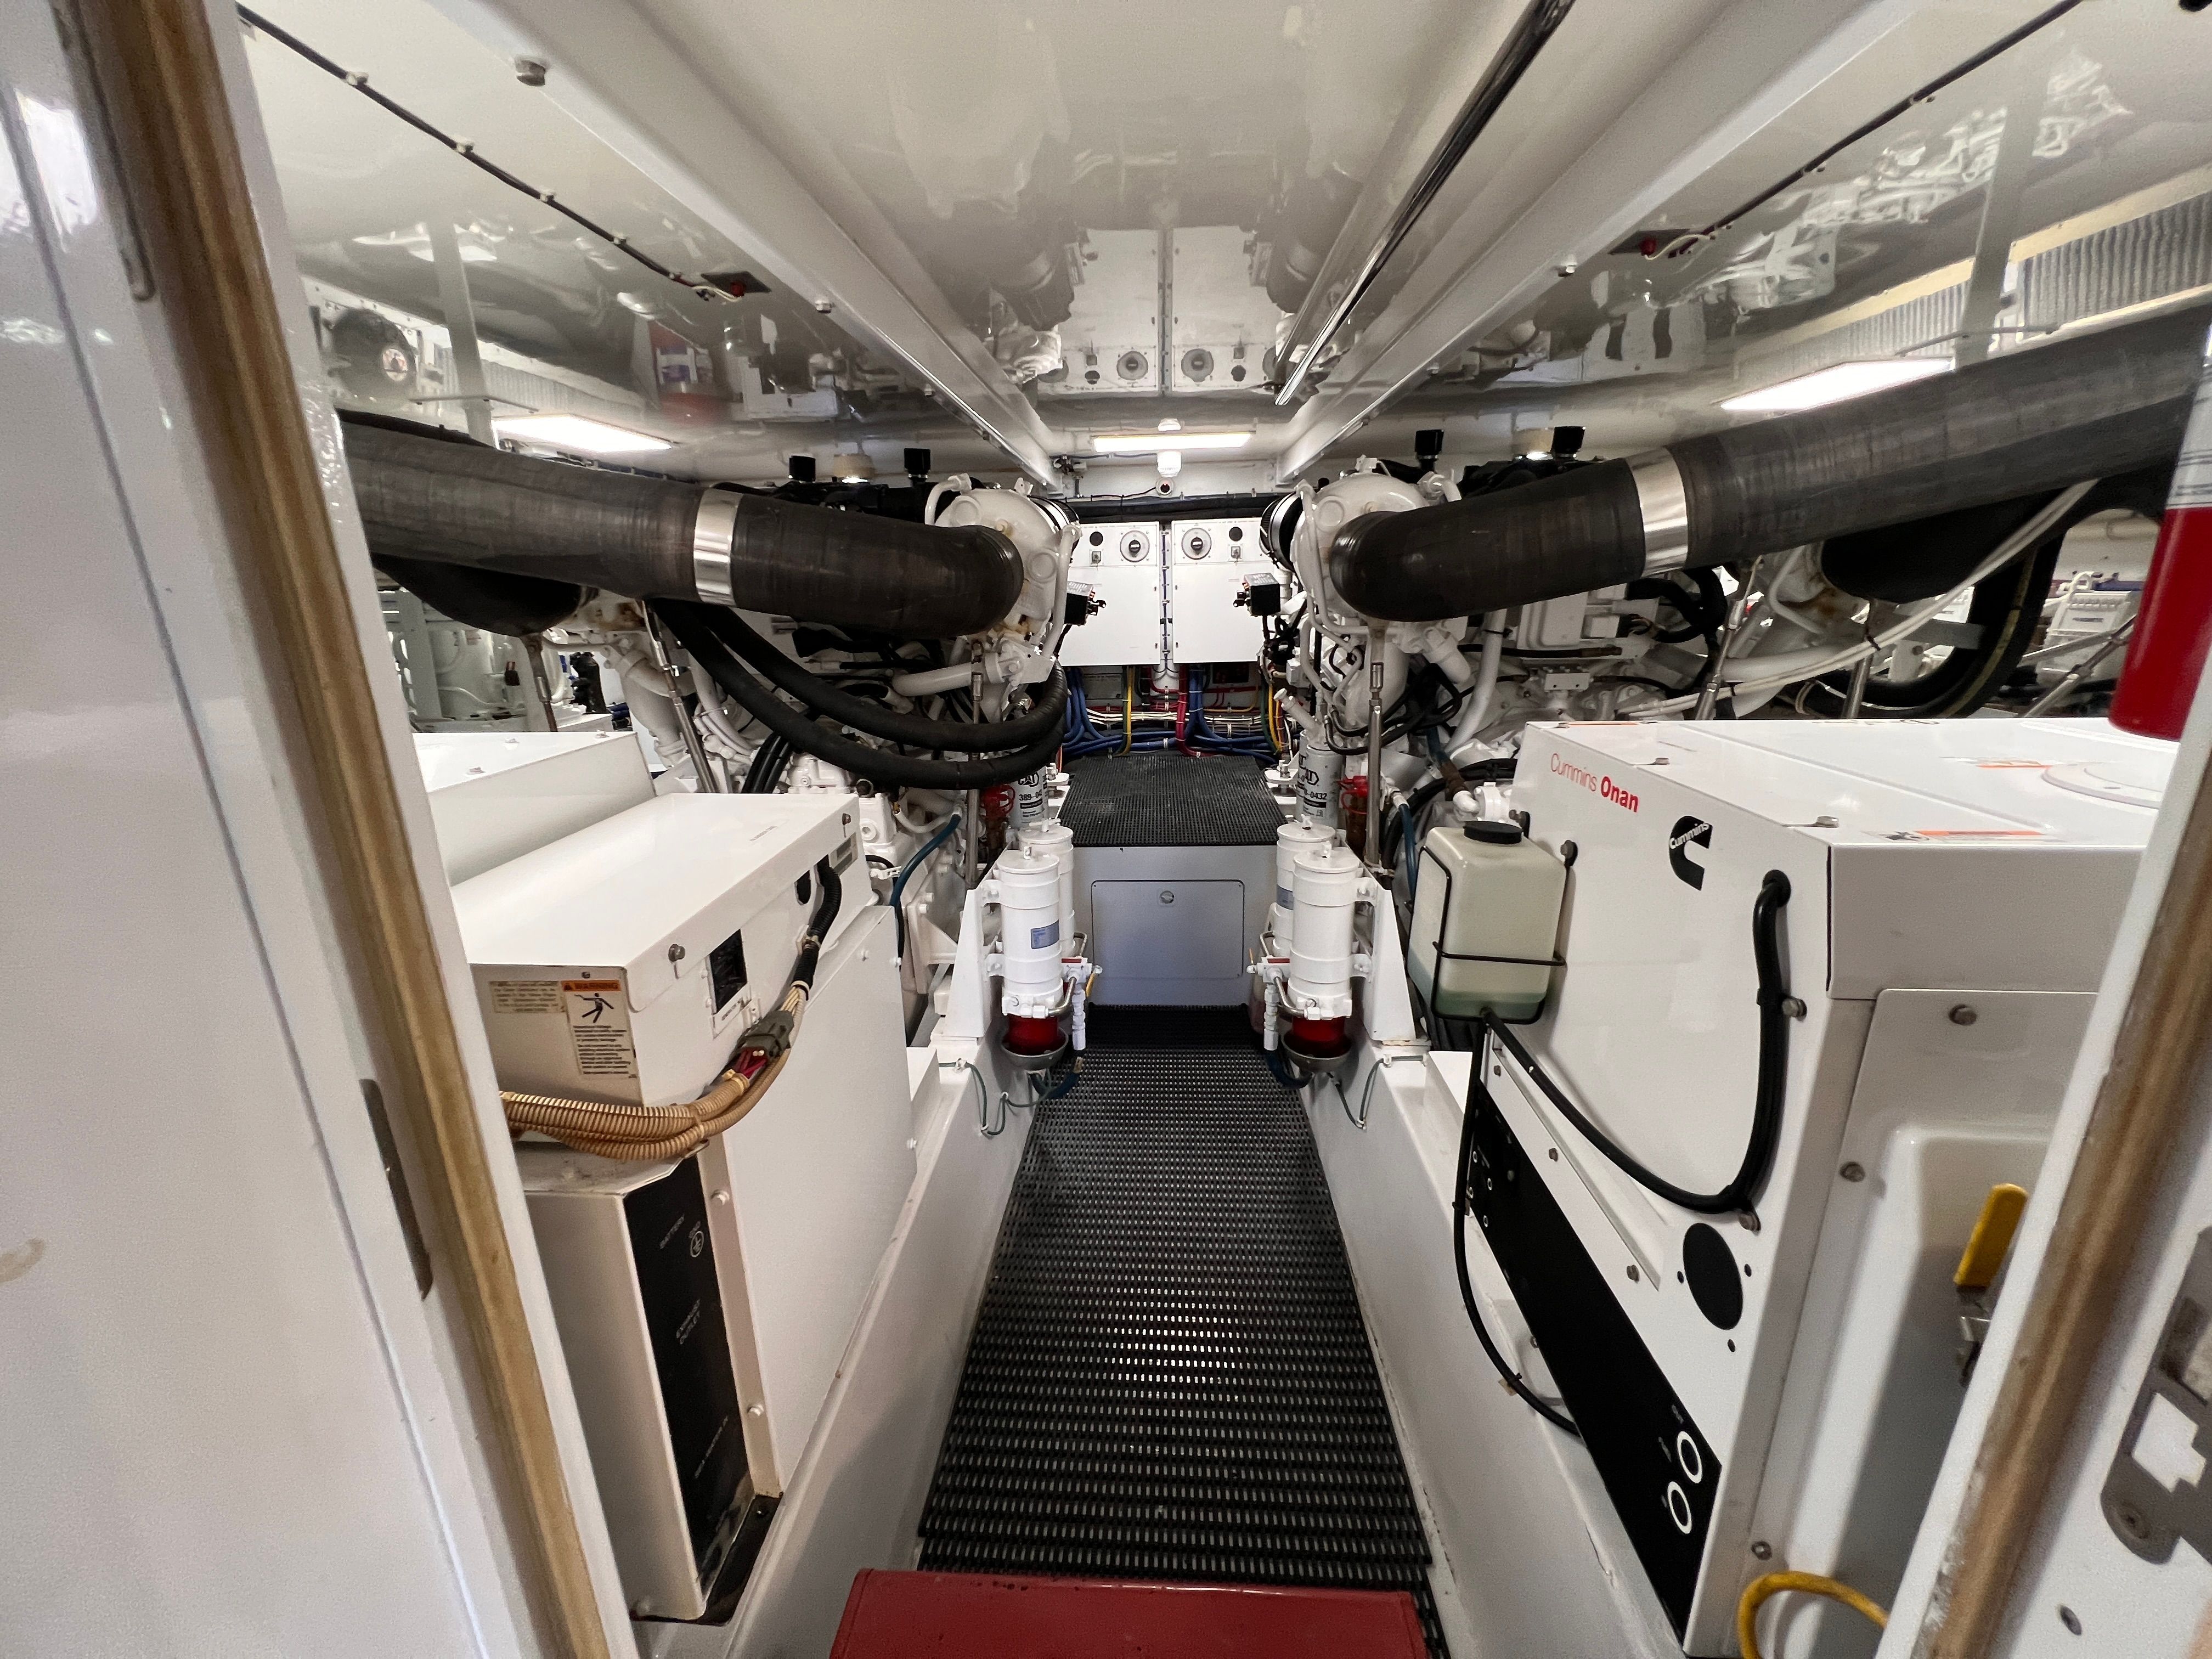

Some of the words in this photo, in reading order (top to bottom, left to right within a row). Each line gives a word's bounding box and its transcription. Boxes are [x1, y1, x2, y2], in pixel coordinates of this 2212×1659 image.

[1019, 789, 1043, 801] 389-04
[1551, 753, 1597, 792] Cummins
[1601, 776, 1639, 812] Onan
[1669, 823, 1709, 849] Cummins
